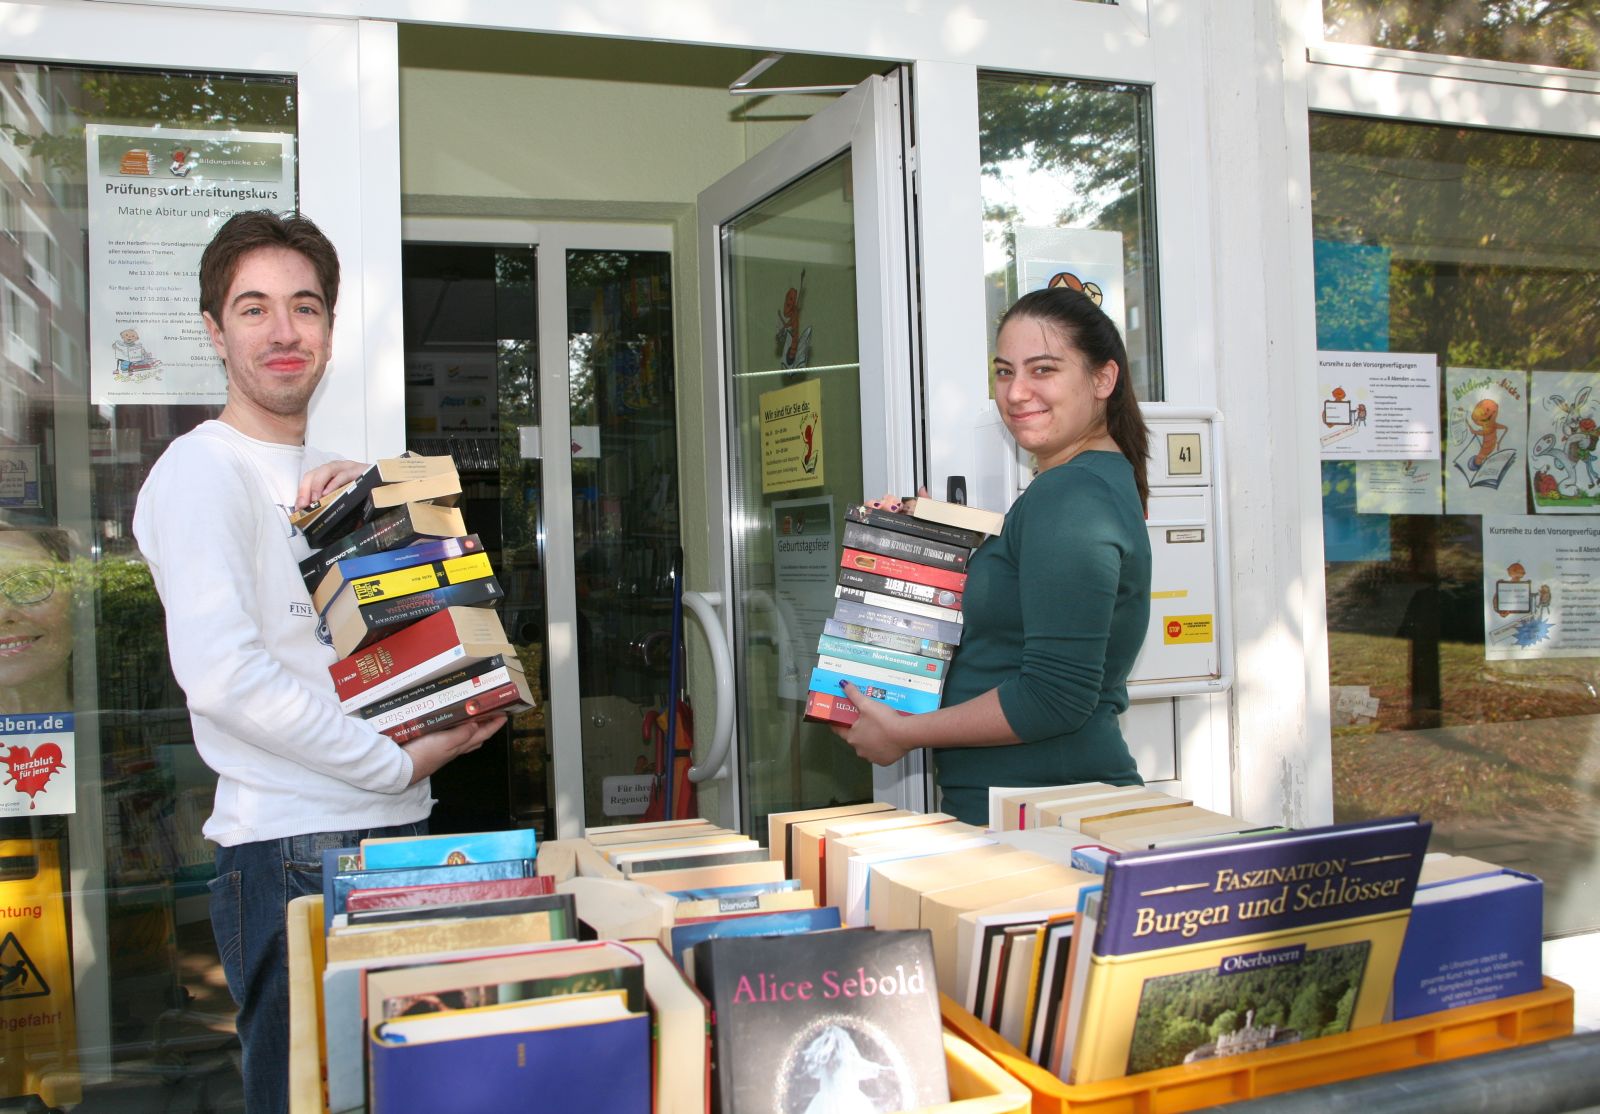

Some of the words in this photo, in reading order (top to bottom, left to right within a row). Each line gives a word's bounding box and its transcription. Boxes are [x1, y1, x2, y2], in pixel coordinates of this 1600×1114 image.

[106, 183, 278, 200] Prüfungsvorbereitungskurs
[155, 206, 188, 217] Abitur
[190, 207, 210, 218] und
[764, 410, 774, 420] Wir
[774, 408, 784, 418] sind
[1178, 446, 1192, 463] 41
[1490, 527, 1524, 535] Kursreihe
[1533, 527, 1546, 535] den
[778, 539, 830, 554] Geburtstagsfeier
[844, 588, 864, 598] PIPER
[405, 699, 435, 715] Graue
[378, 711, 405, 726] Stars
[14, 756, 54, 772] herzblut
[20, 768, 31, 780] für
[32, 767, 49, 777] jena
[618, 784, 632, 793] Für
[1213, 858, 1346, 894] FASZINATION
[720, 900, 758, 912] blanvalet
[1132, 903, 1230, 937] Burgen
[1238, 886, 1289, 920] und
[1293, 876, 1405, 913] Schlösser
[1223, 950, 1300, 972] Oberbayern
[732, 972, 814, 1005] Alice
[821, 961, 925, 999] Sebold
